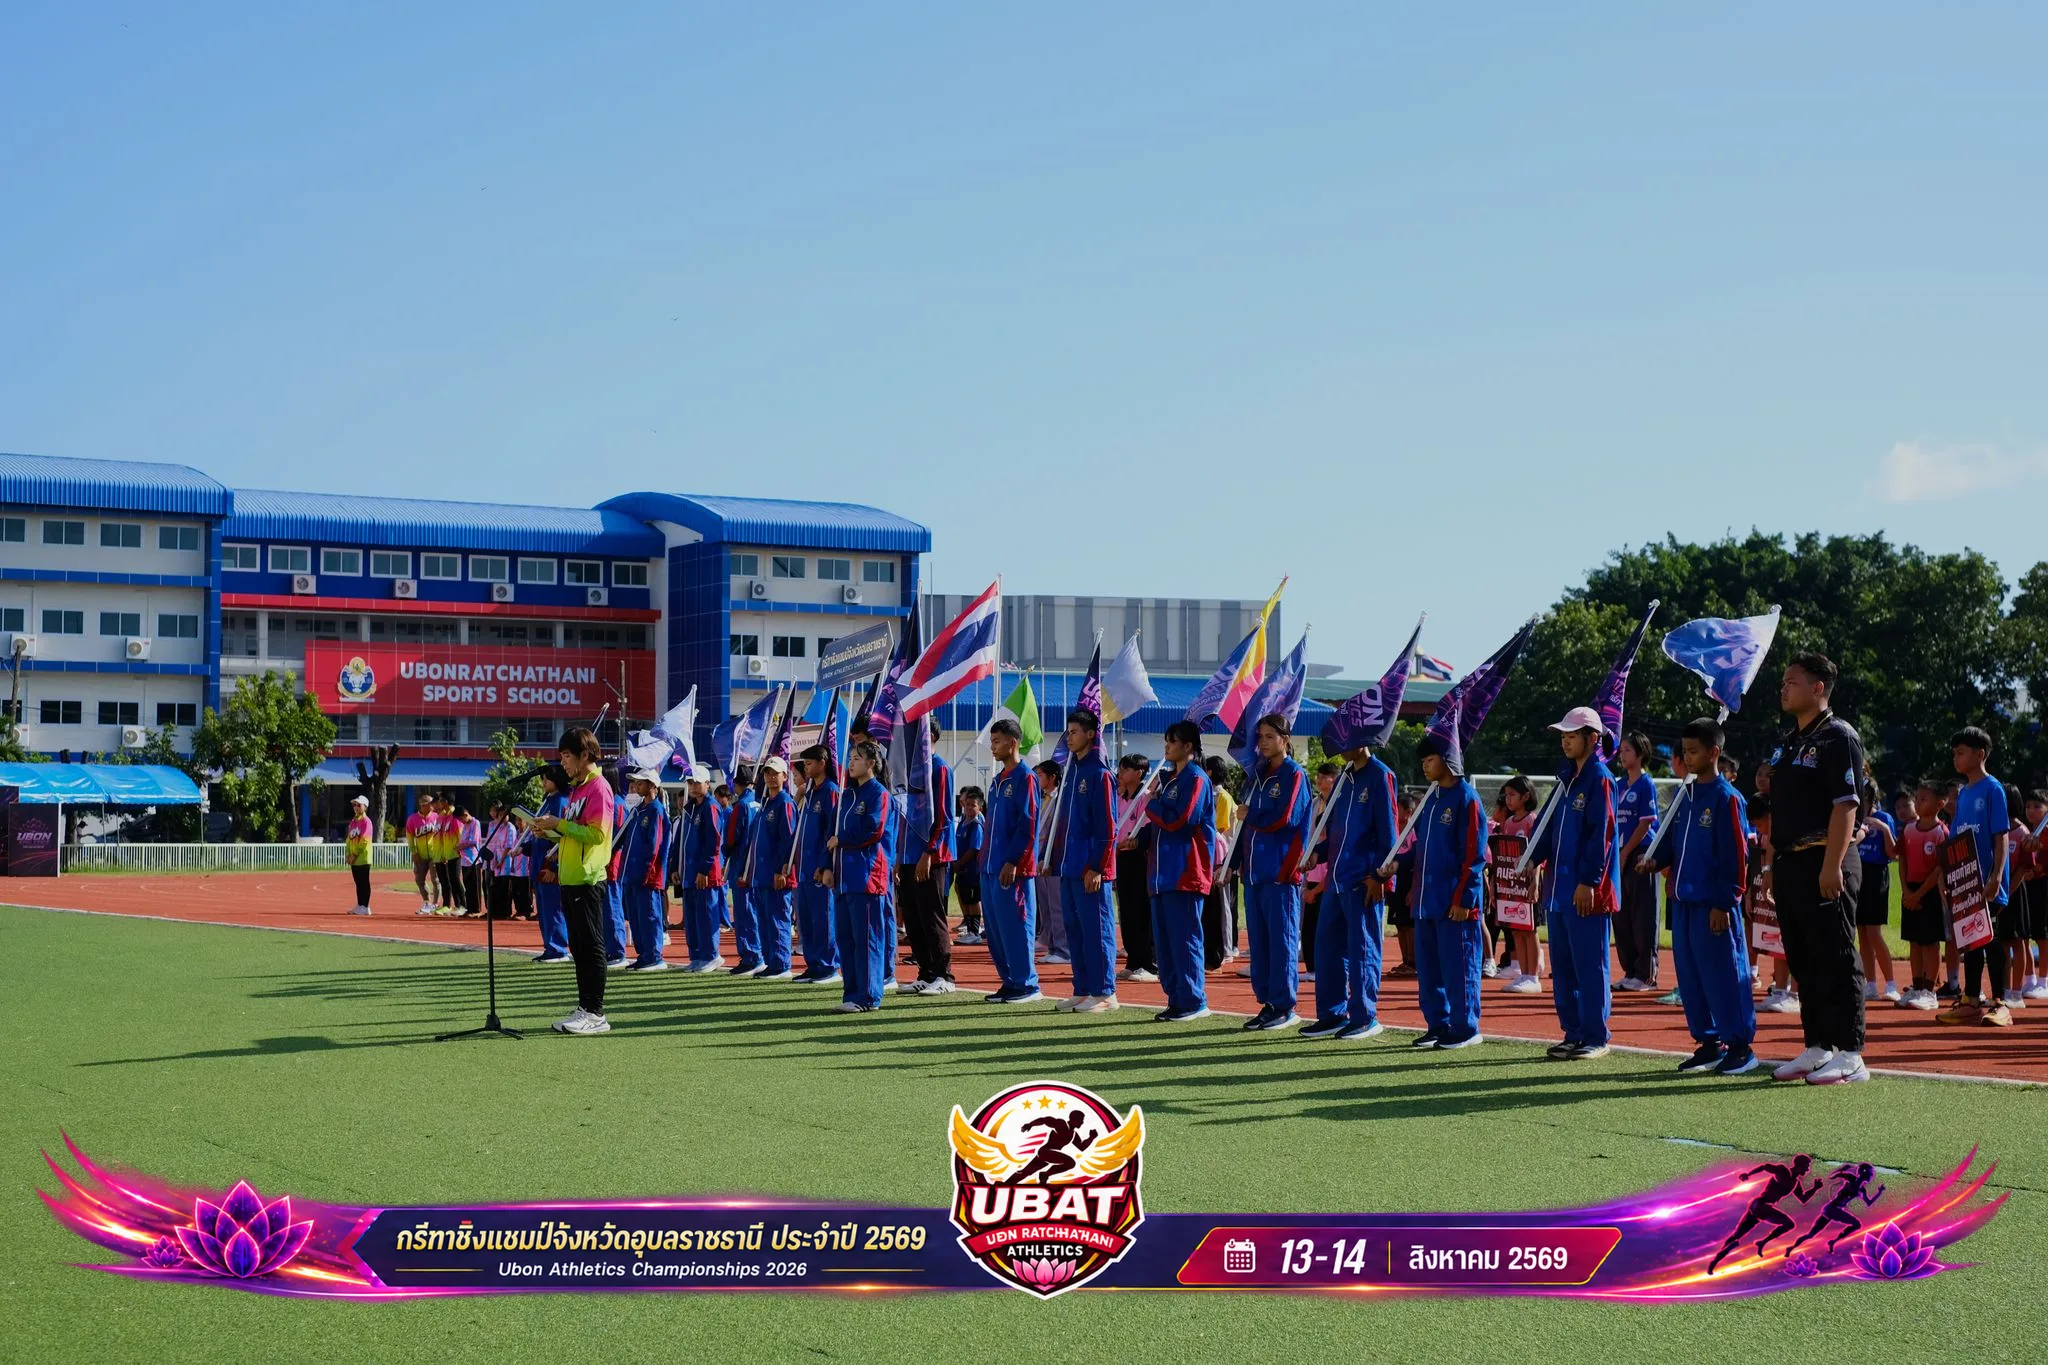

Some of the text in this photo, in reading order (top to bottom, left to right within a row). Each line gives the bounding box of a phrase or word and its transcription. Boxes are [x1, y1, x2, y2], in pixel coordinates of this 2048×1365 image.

[401, 662, 595, 684] UBONRATCHATHANI
[423, 685, 581, 705] SPORTS SCHOOL
[17, 832, 52, 841] UBON
